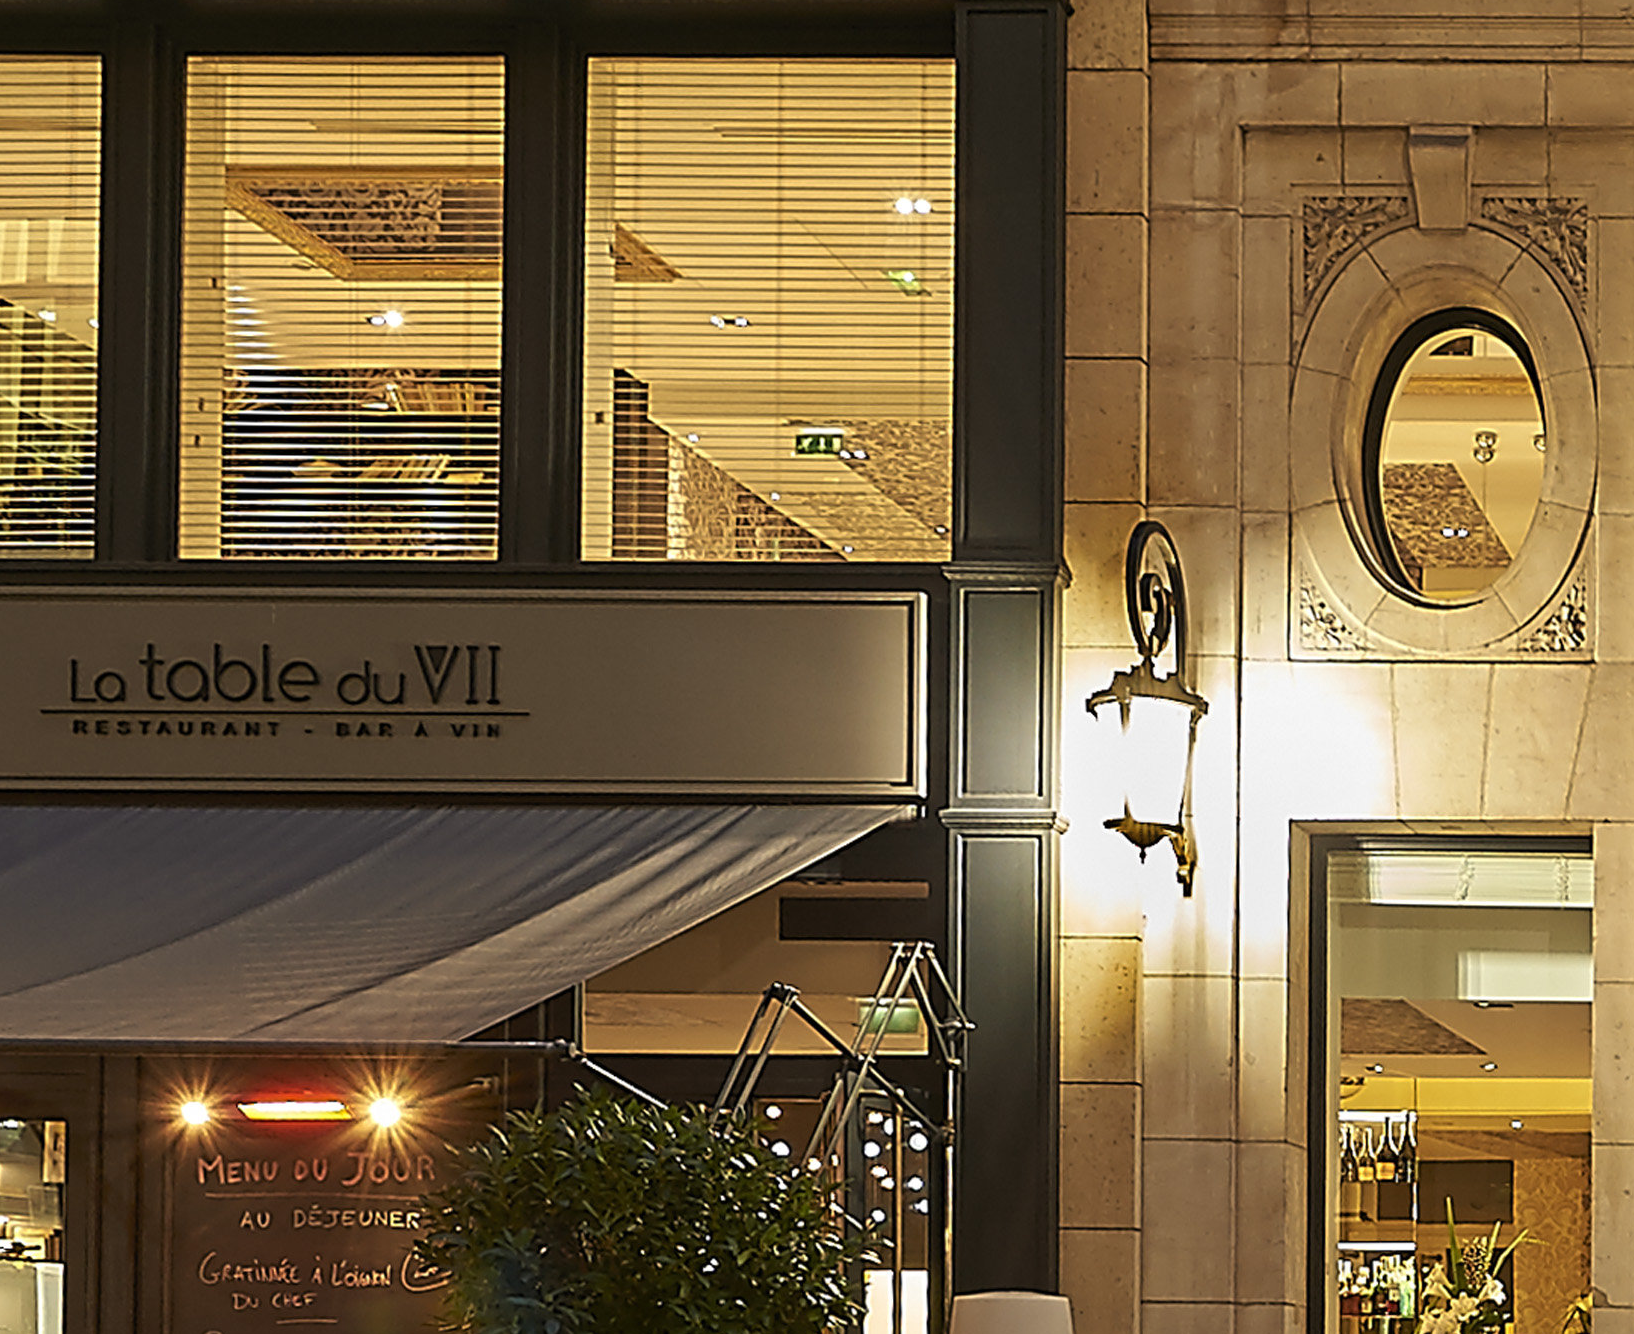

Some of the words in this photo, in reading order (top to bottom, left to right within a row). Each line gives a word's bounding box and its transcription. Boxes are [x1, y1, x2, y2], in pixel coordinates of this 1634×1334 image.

[70, 659, 126, 703] La
[139, 643, 320, 703] table
[337, 660, 407, 705] du
[413, 644, 502, 706] VII
[72, 719, 281, 737] RESTAURANT
[336, 722, 393, 738] BAR
[451, 722, 502, 738] VIN
[197, 1153, 279, 1185] MENU
[293, 1157, 328, 1182] DU
[340, 1151, 436, 1187] JOUR
[239, 1211, 271, 1231] AU
[292, 1203, 422, 1231] DÉJEUNER
[231, 1292, 260, 1310] DU
[271, 1291, 318, 1309] CHEF
